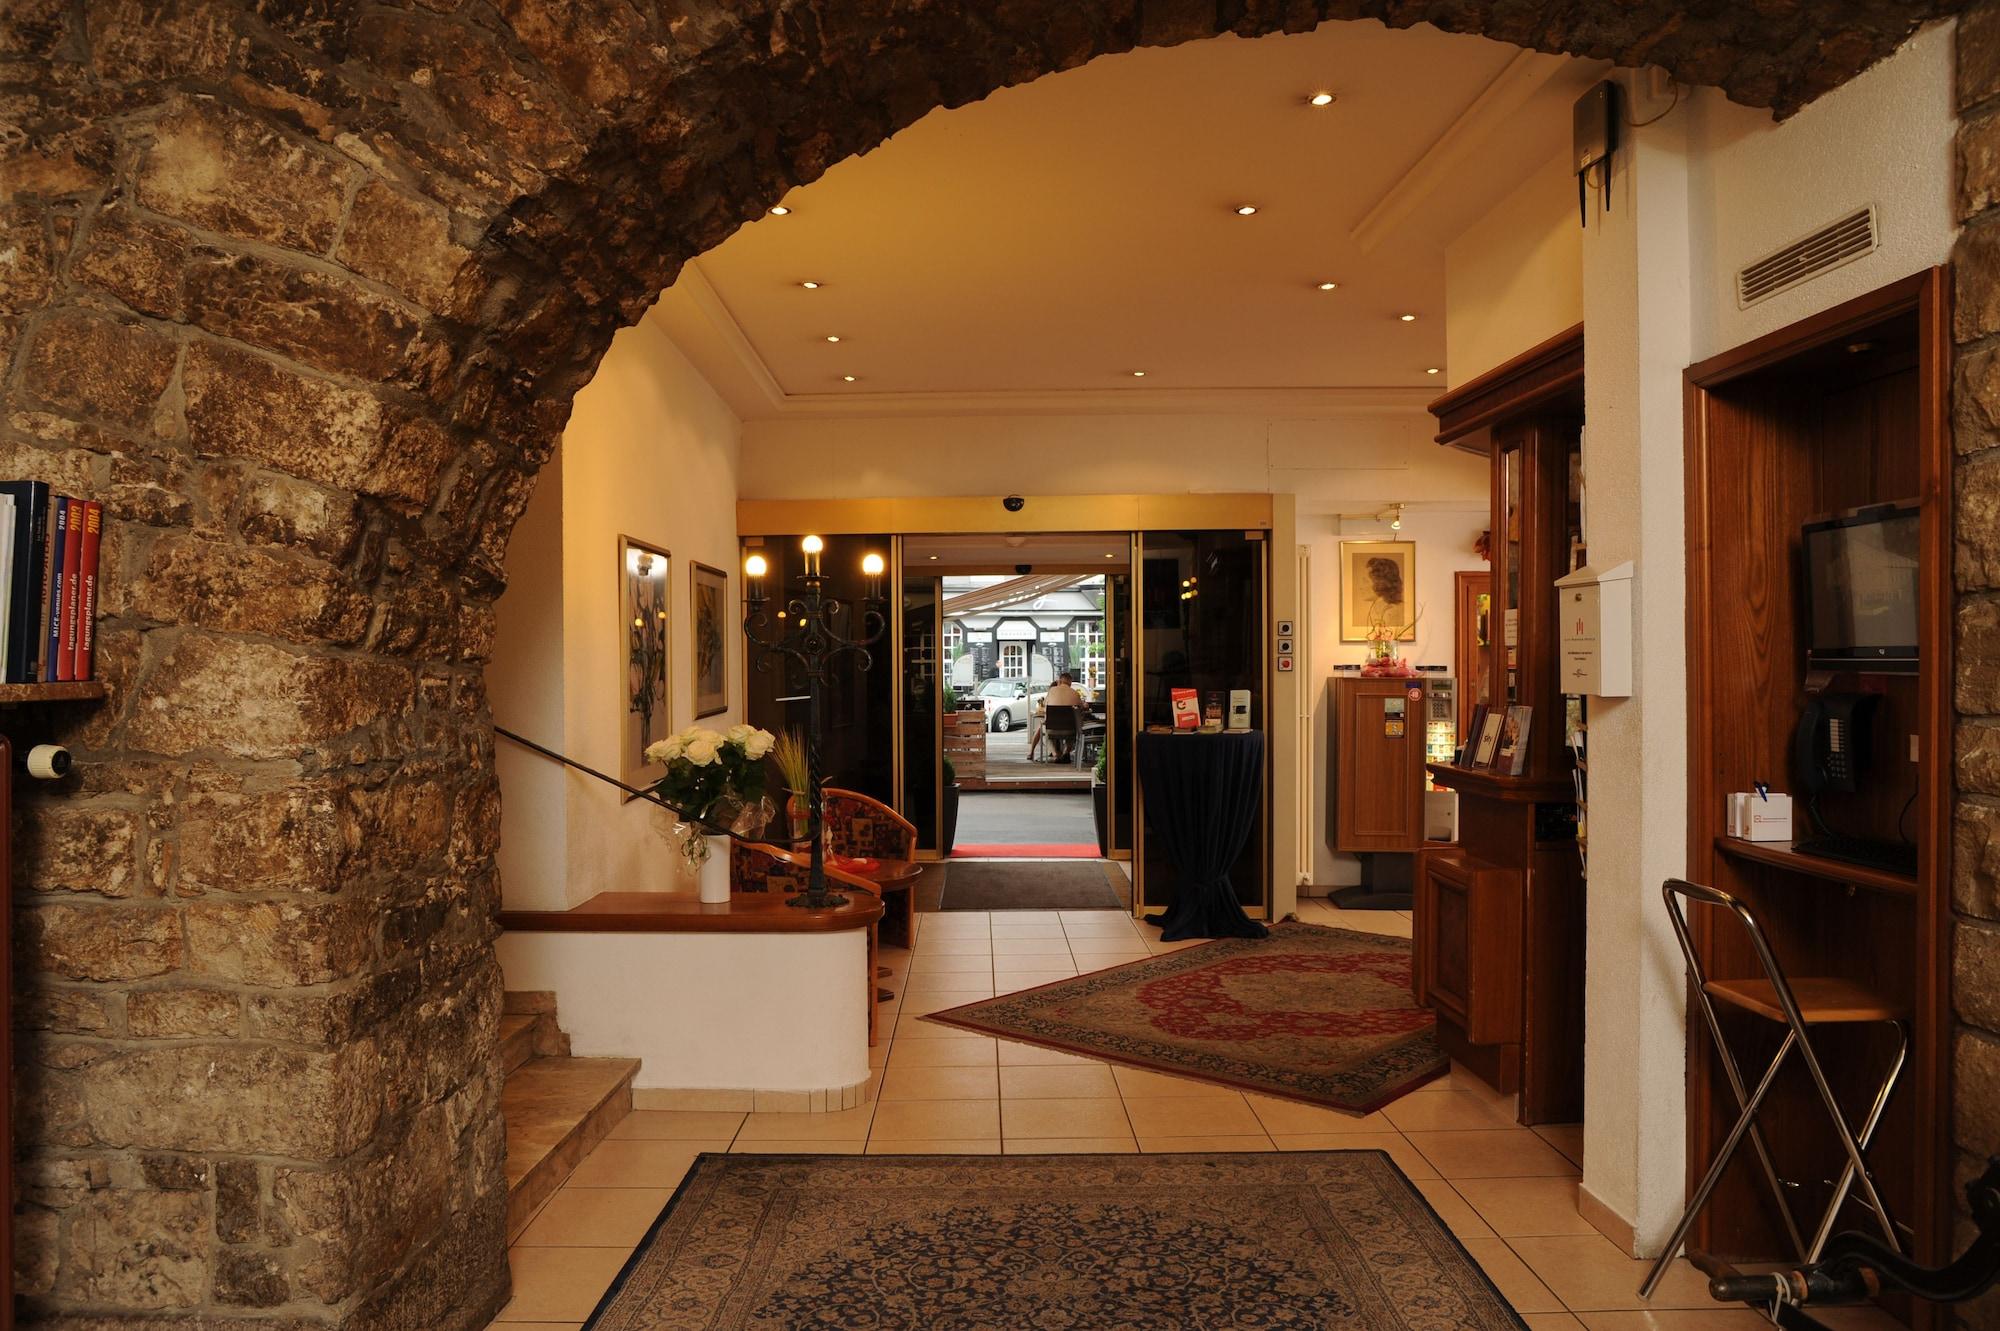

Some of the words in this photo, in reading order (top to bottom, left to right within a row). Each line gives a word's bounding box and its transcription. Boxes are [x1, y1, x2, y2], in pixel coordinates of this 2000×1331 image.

[58, 510, 66, 530] 2004
[70, 505, 82, 532] 2003
[87, 508, 100, 535] 2004
[52, 573, 63, 638] MICE-venues.com
[67, 573, 78, 651] tagungsplaner.de
[83, 574, 94, 651] tagungsplaner.de
